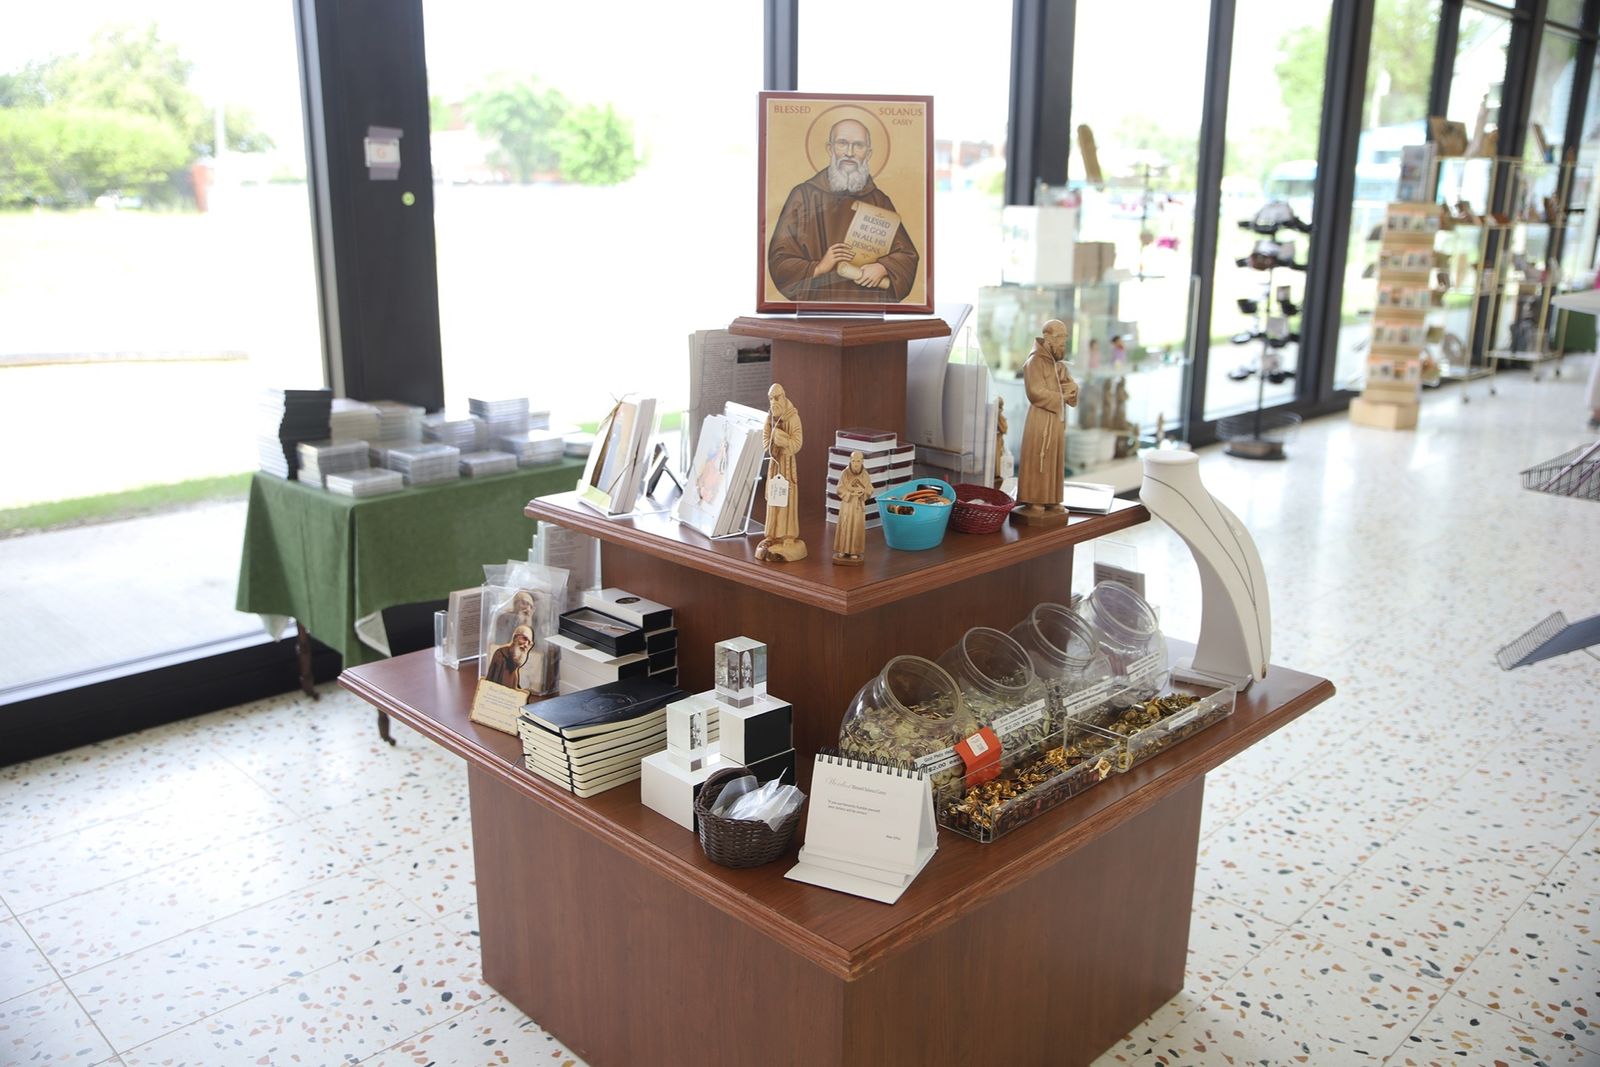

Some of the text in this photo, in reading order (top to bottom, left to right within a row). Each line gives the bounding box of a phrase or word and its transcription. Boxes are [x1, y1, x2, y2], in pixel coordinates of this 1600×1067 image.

[774, 105, 923, 117] BLESSED SOLANUS
[892, 118, 913, 126] CASEY
[863, 214, 891, 229] BLESSED
[860, 223, 887, 237] BE GOD
[861, 234, 872, 242] ALL
[928, 762, 947, 772] $2.00
